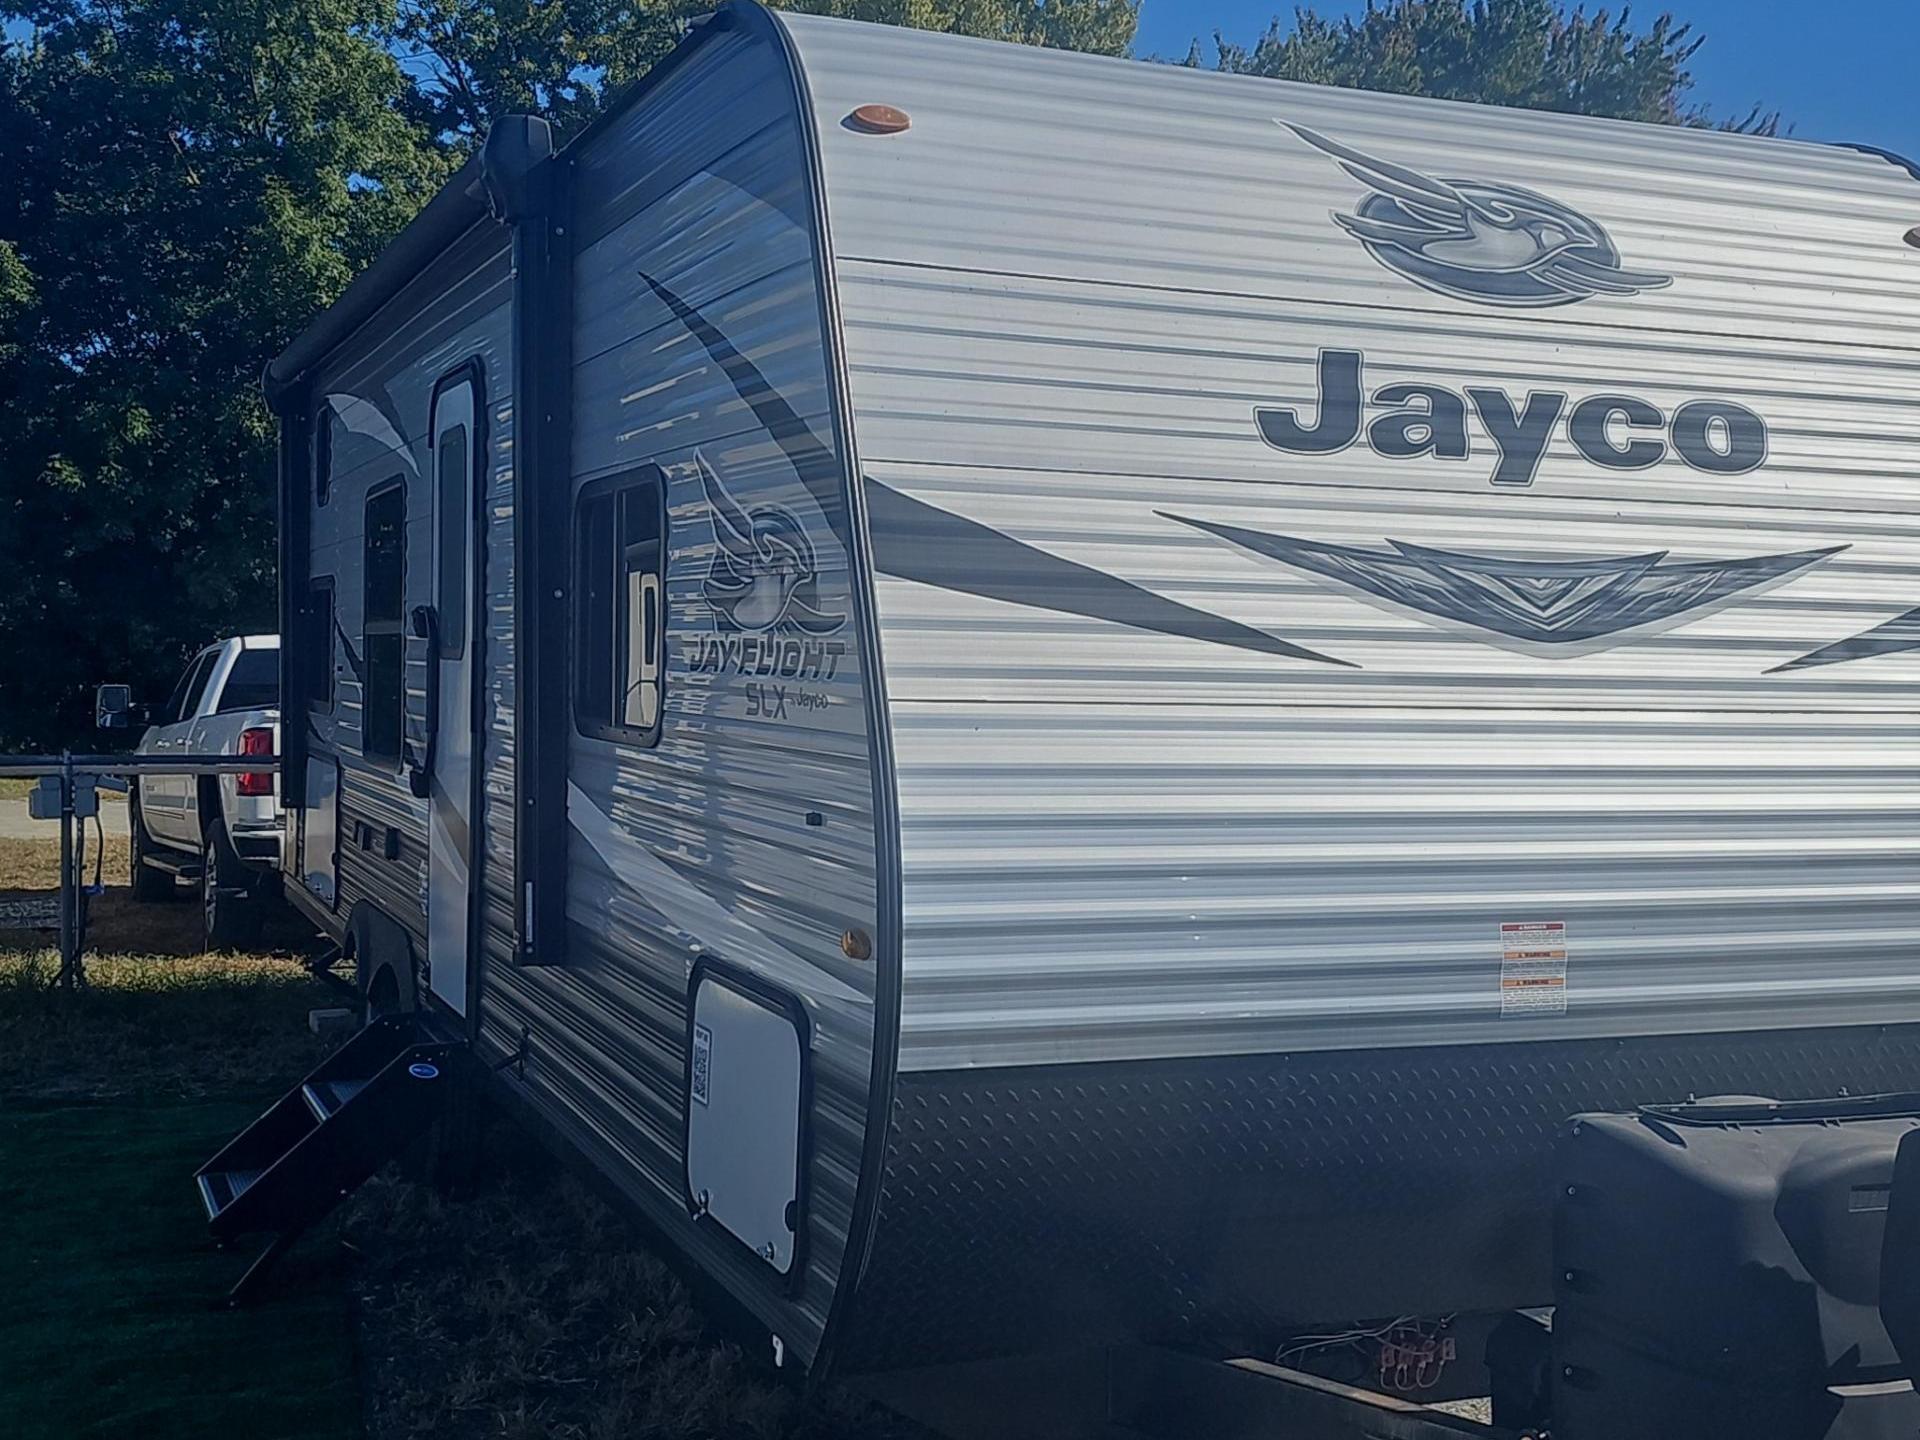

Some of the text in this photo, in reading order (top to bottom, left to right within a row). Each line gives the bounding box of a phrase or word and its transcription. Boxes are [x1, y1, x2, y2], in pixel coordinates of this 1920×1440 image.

[1254, 347, 1768, 487] Jayco
[745, 682, 829, 720] SLX Jayco
